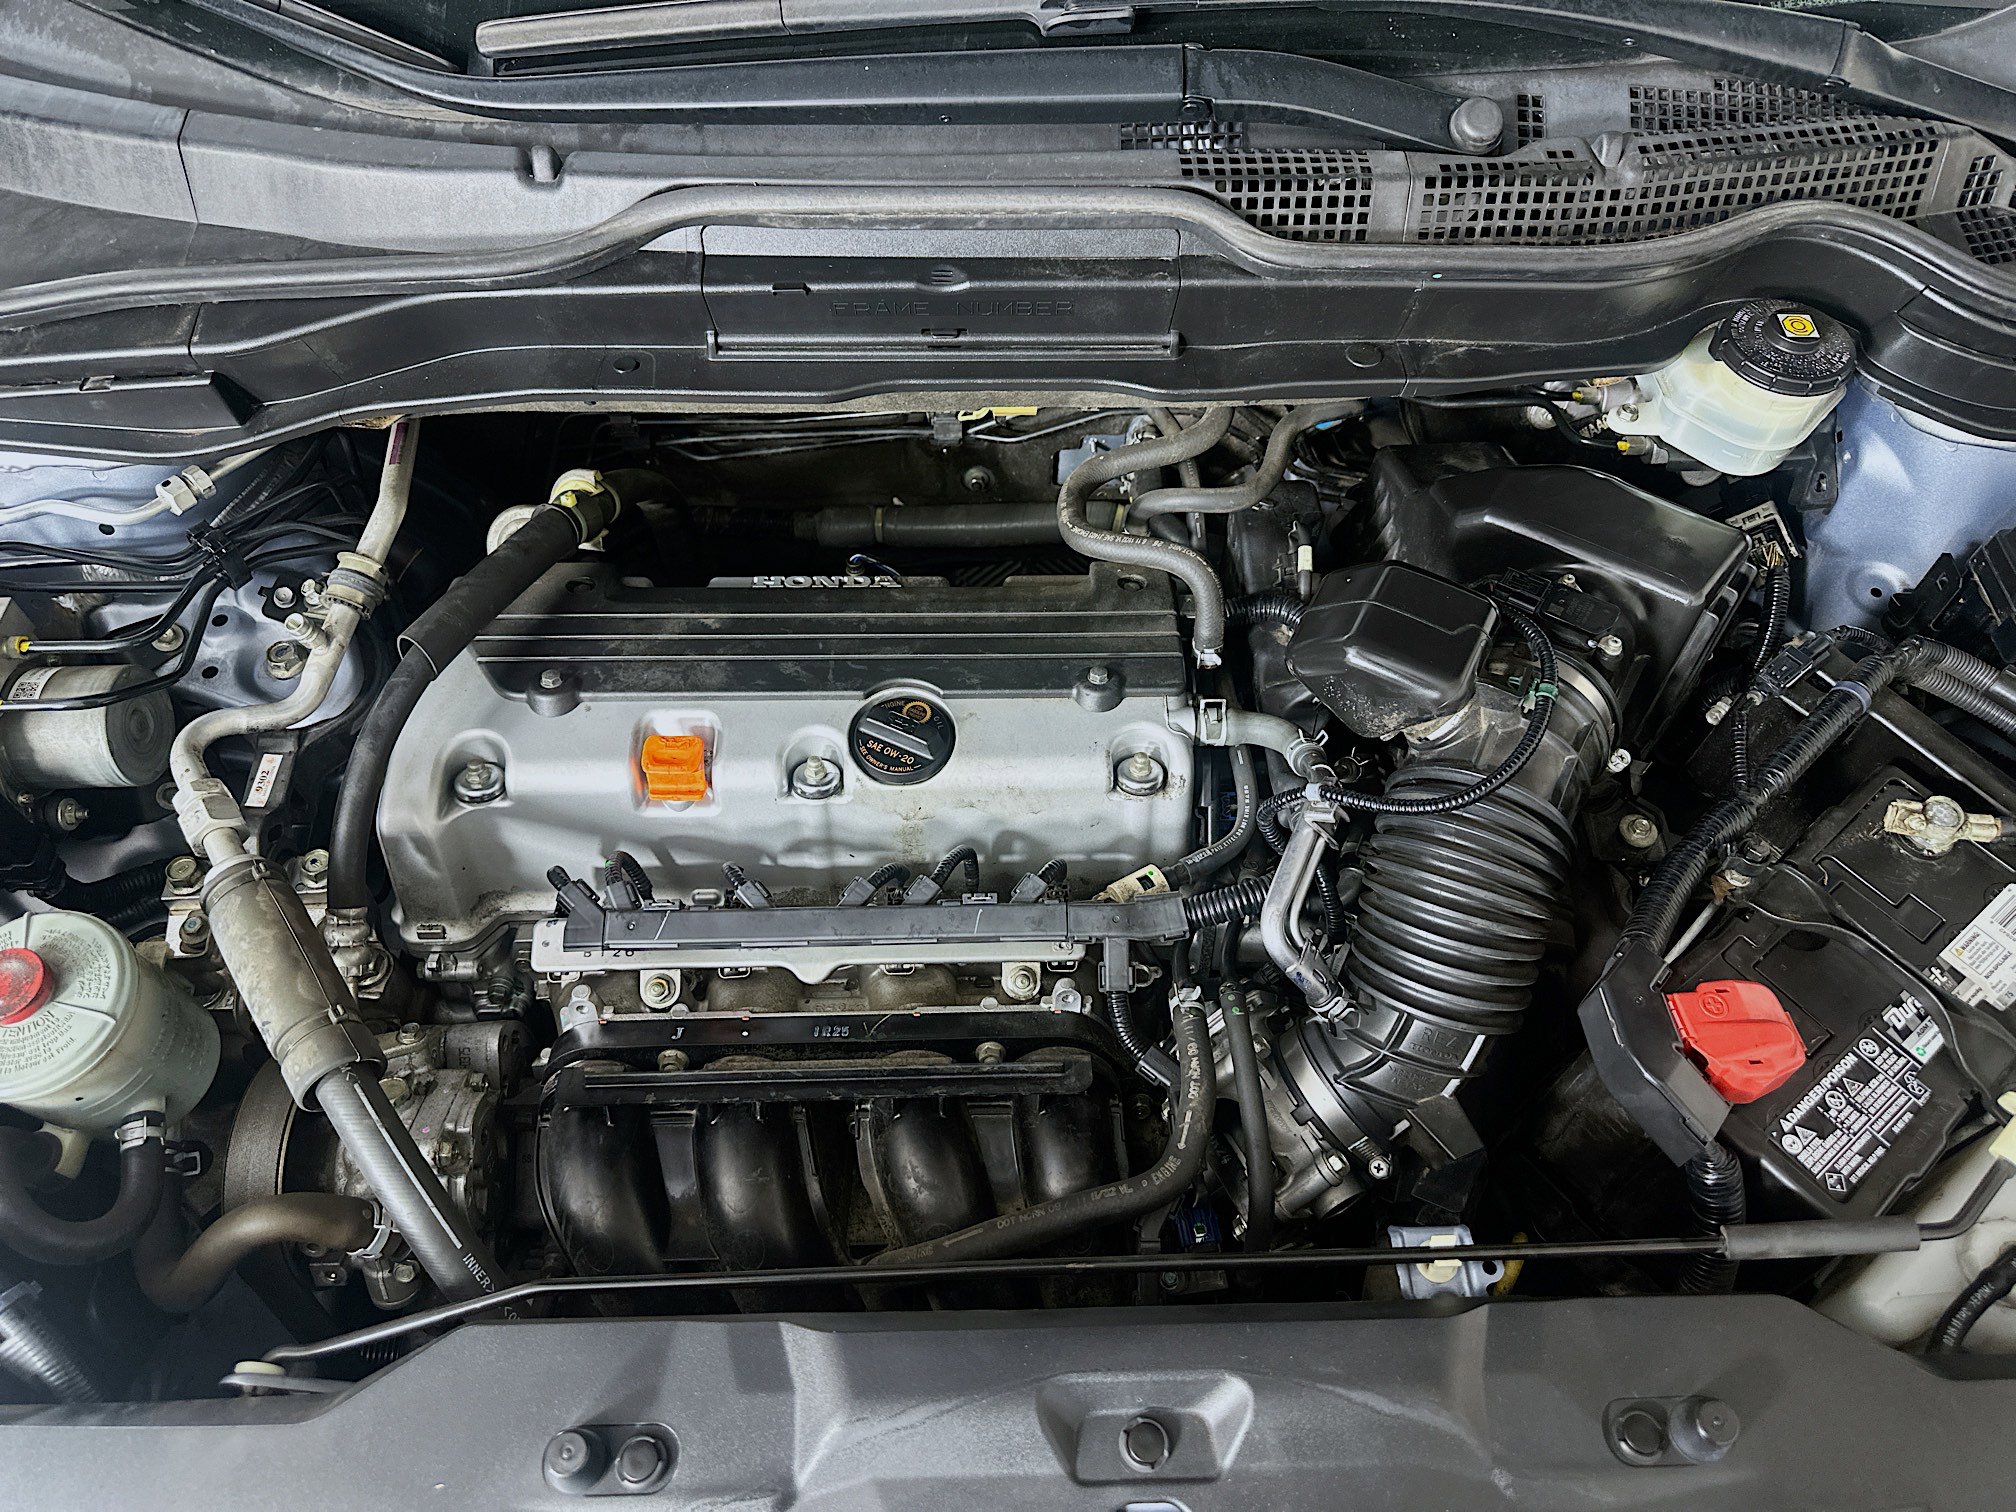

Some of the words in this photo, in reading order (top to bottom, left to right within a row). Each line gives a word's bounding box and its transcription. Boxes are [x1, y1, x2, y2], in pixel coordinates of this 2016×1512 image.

[833, 302, 930, 316] FRAME
[956, 302, 1074, 316] NUMBER
[752, 575, 902, 588] HONDA
[866, 740, 884, 753] SAE
[866, 755, 888, 770] OWNER'S
[255, 770, 270, 792] 9302
[1785, 1052, 1859, 1125] DANGER/POISON
[1151, 1154, 1183, 1186] ENGINE
